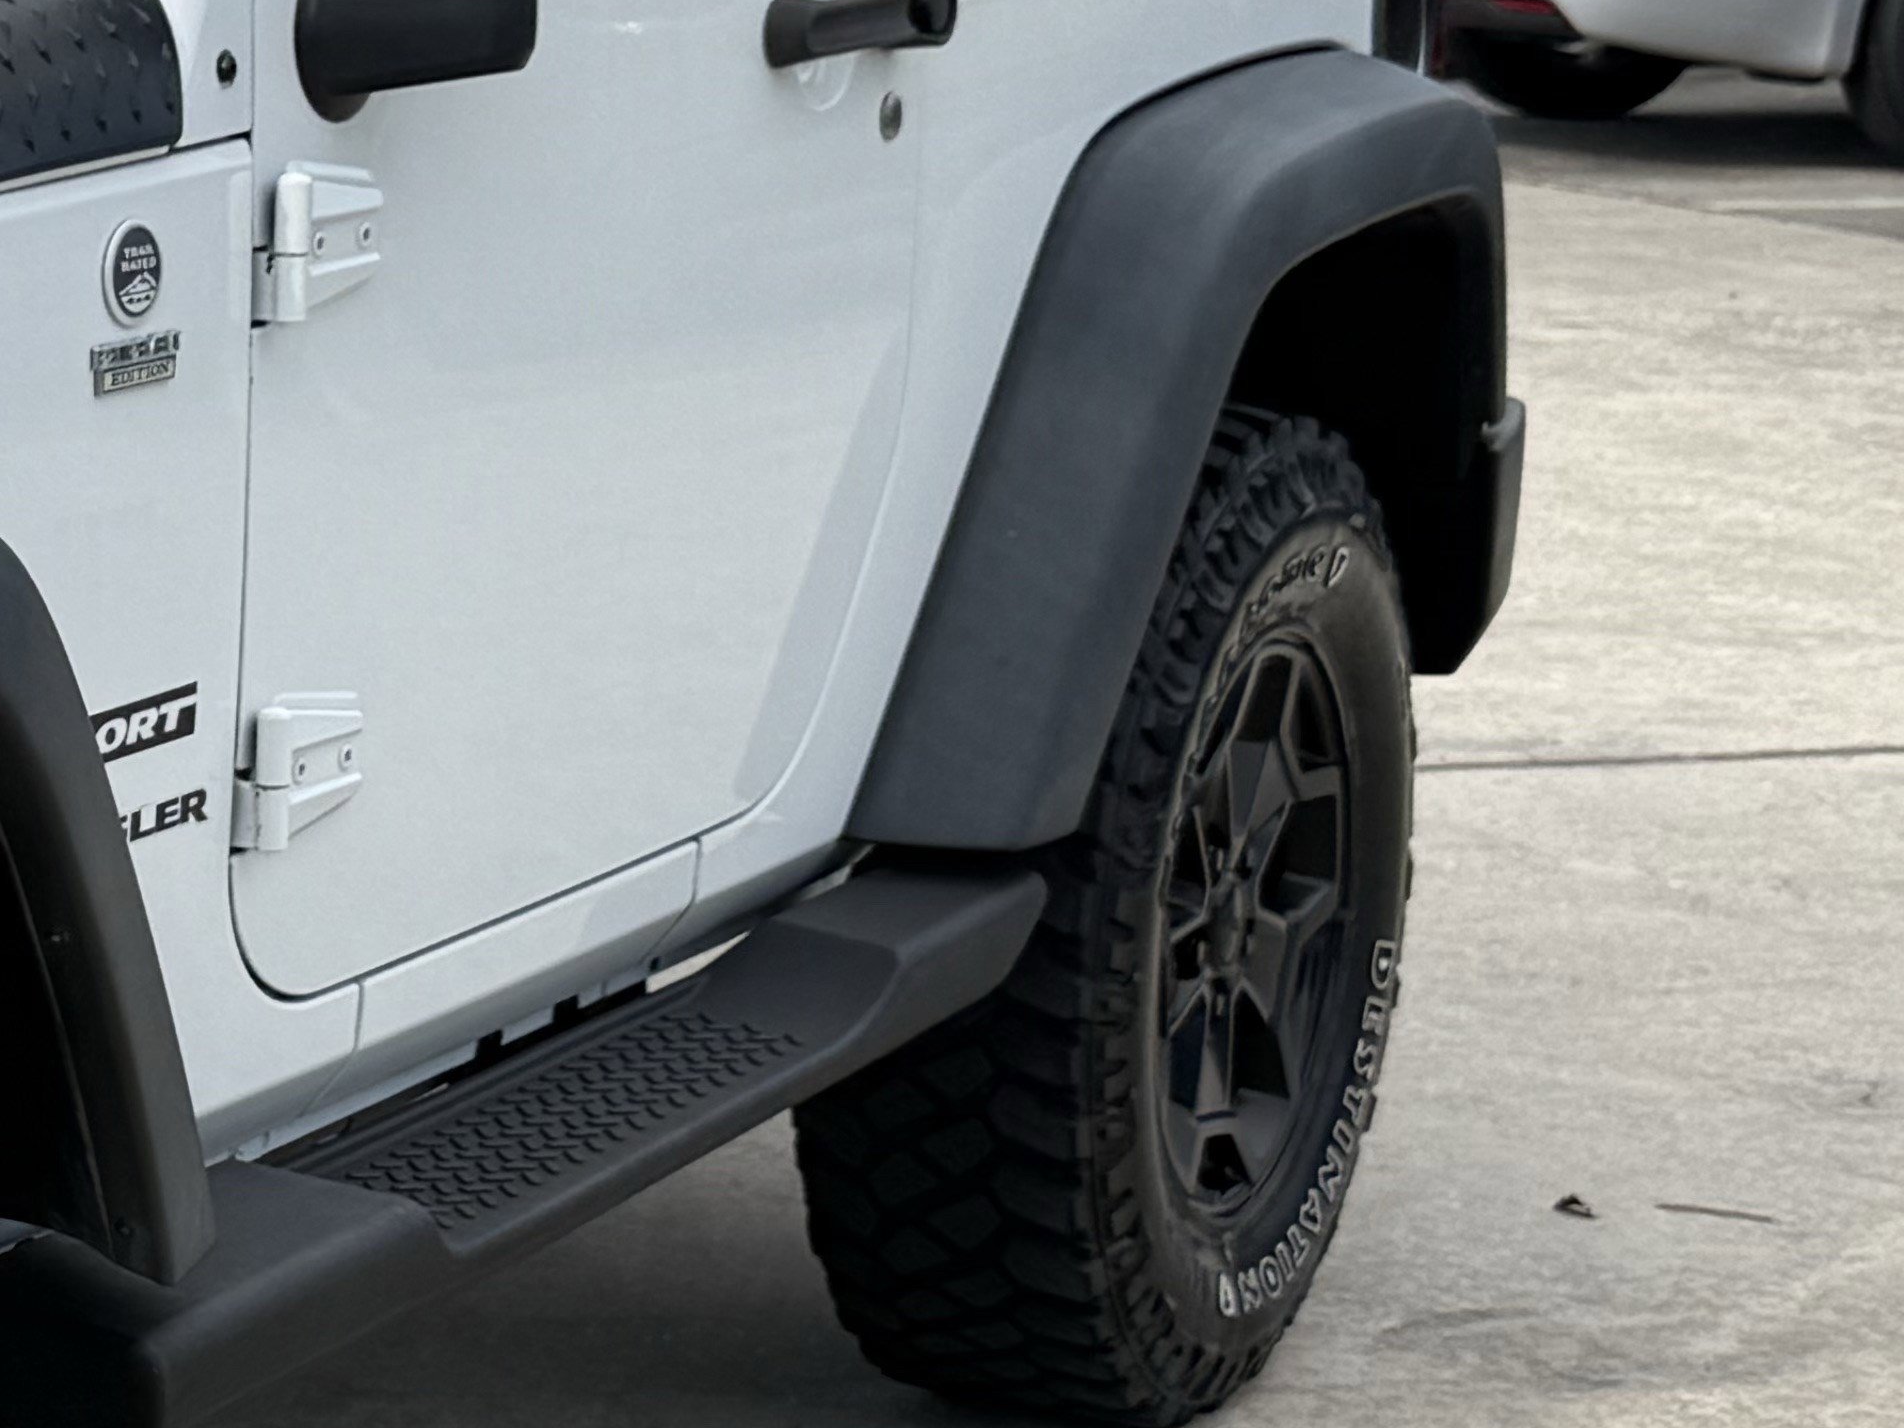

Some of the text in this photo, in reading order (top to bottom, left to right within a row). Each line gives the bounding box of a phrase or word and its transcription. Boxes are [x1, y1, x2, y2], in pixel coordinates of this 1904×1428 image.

[110, 361, 170, 386] EDITION
[95, 692, 198, 755] ORT
[120, 788, 208, 843] LER
